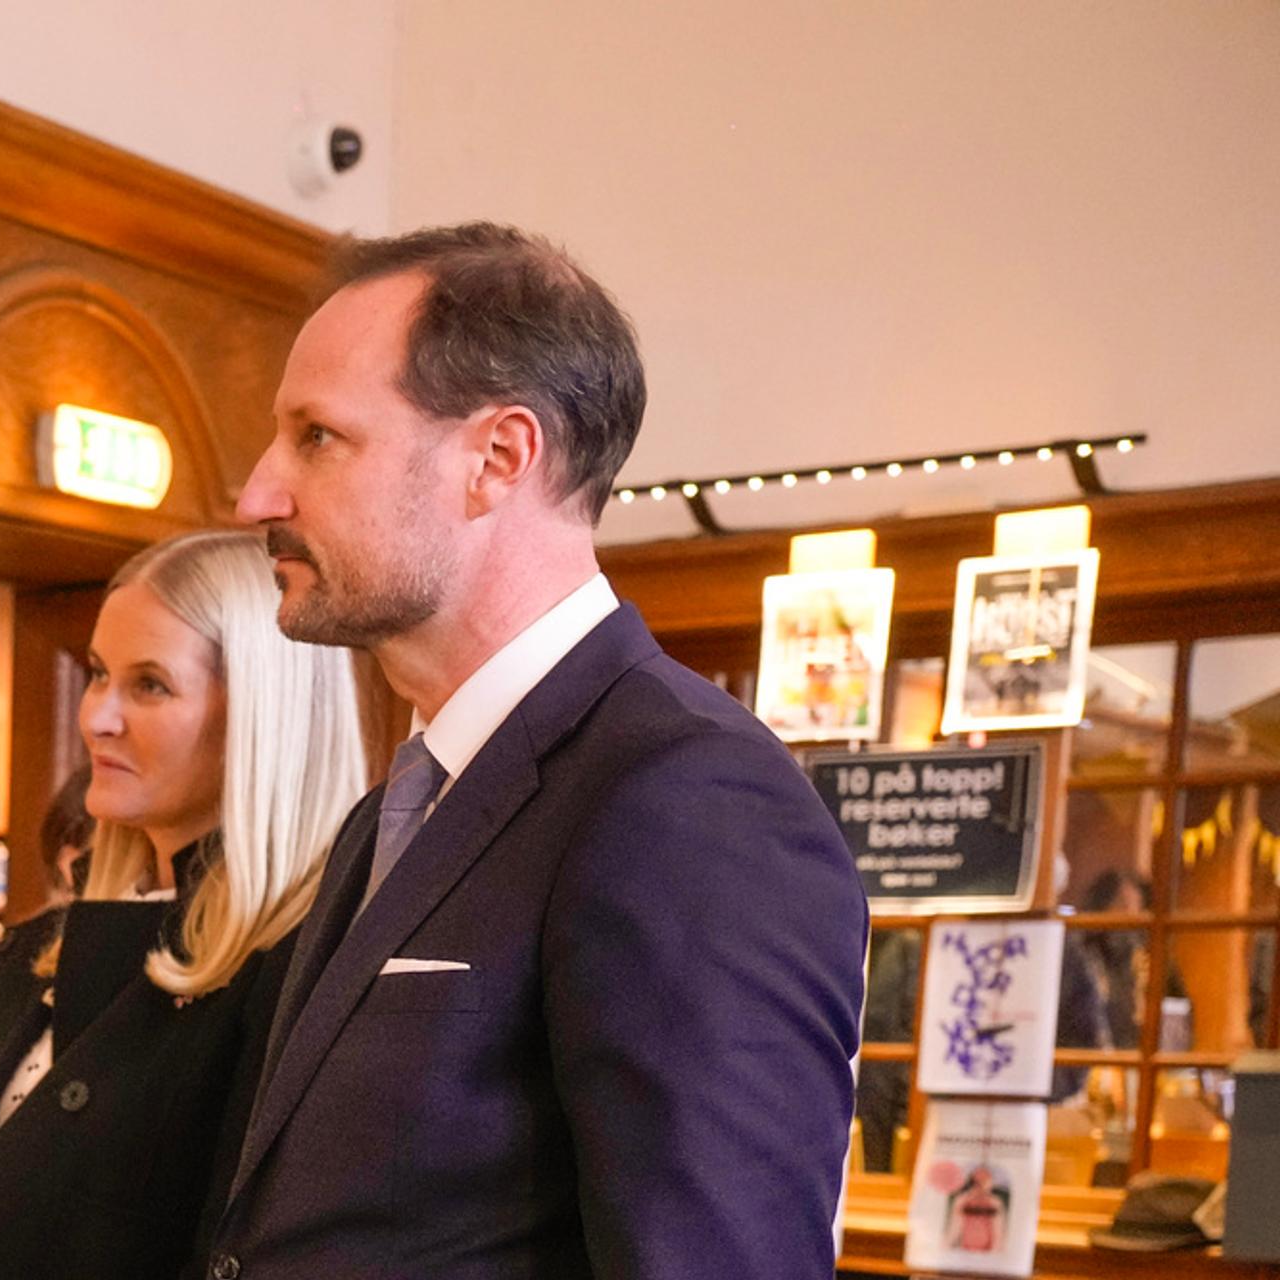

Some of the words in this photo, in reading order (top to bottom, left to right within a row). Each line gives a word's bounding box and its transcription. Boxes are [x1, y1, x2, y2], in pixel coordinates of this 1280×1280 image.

[837, 765, 871, 796] 10
[873, 761, 918, 800] på
[841, 794, 991, 823] reserverte
[866, 819, 961, 849] bøker
